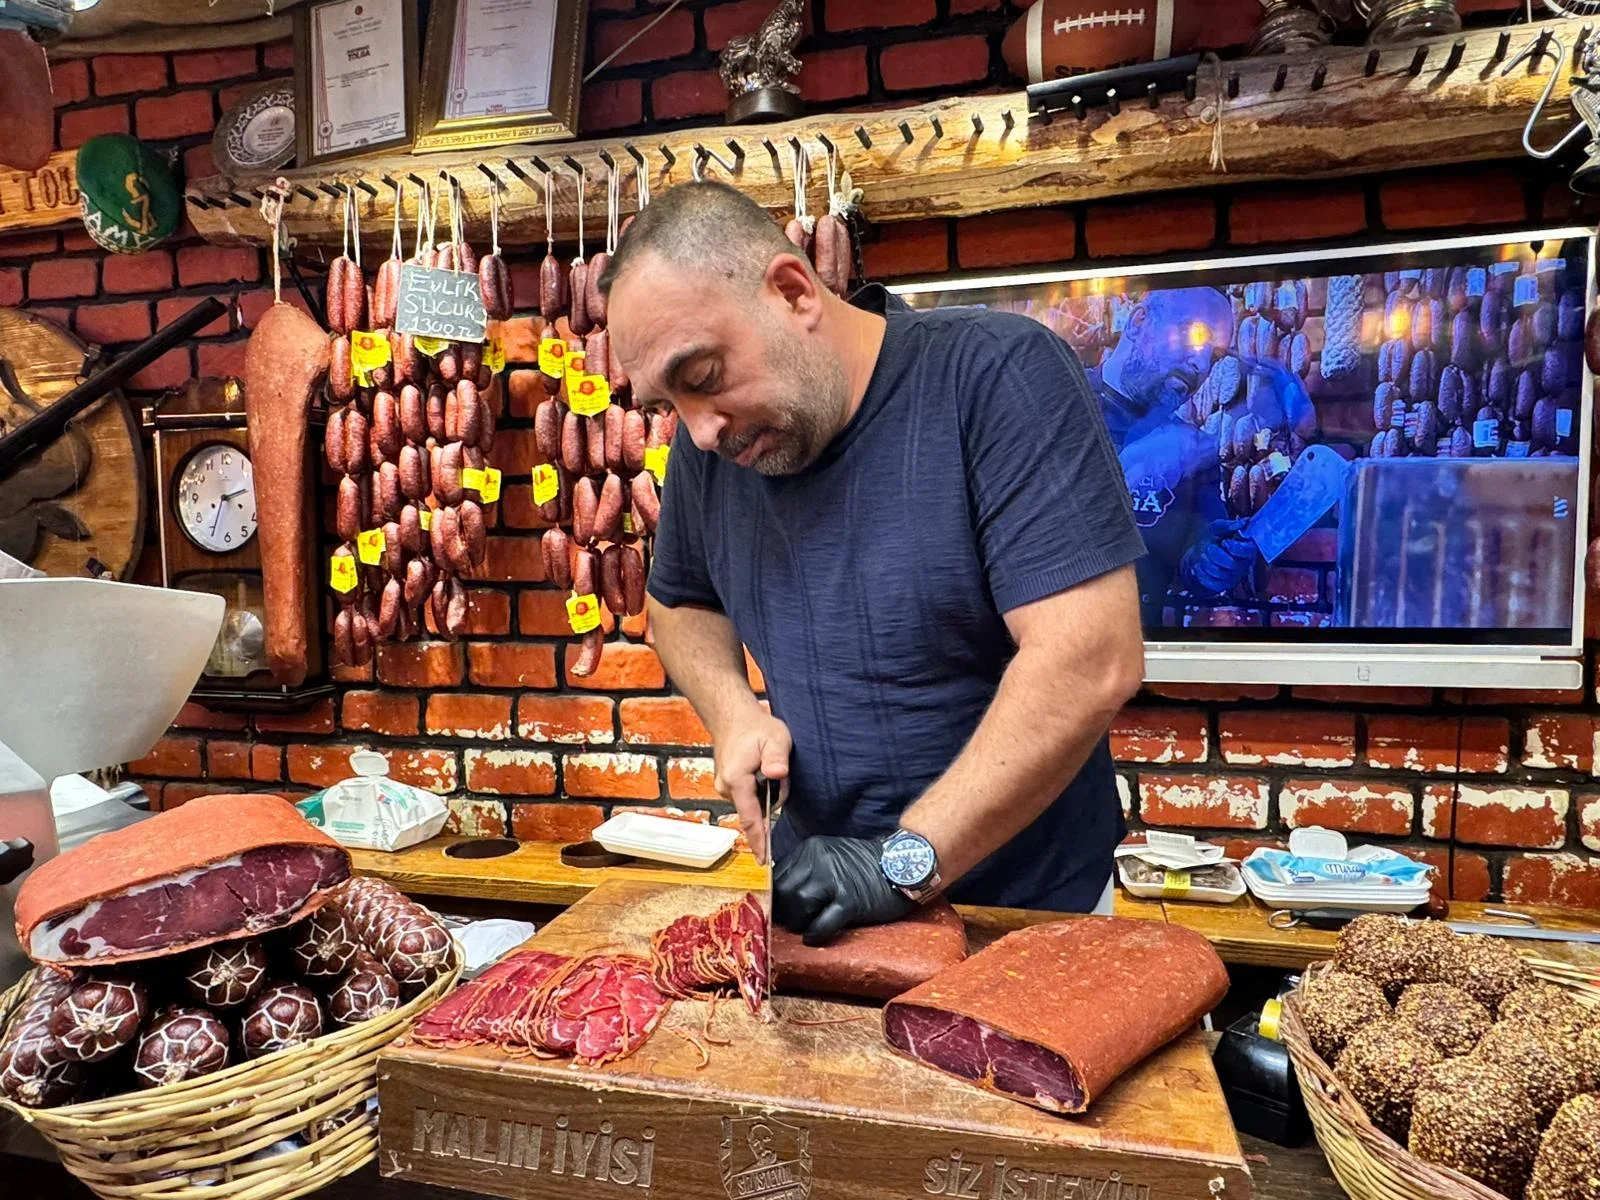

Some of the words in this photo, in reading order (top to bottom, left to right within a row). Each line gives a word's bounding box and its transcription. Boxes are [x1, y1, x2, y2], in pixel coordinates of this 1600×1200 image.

[403, 293, 475, 320] SUCUK
[240, 525, 249, 538] 5
[412, 1106, 543, 1170] MALIN
[551, 1114, 657, 1189] İYİSİ
[922, 1147, 983, 1200] SİZ
